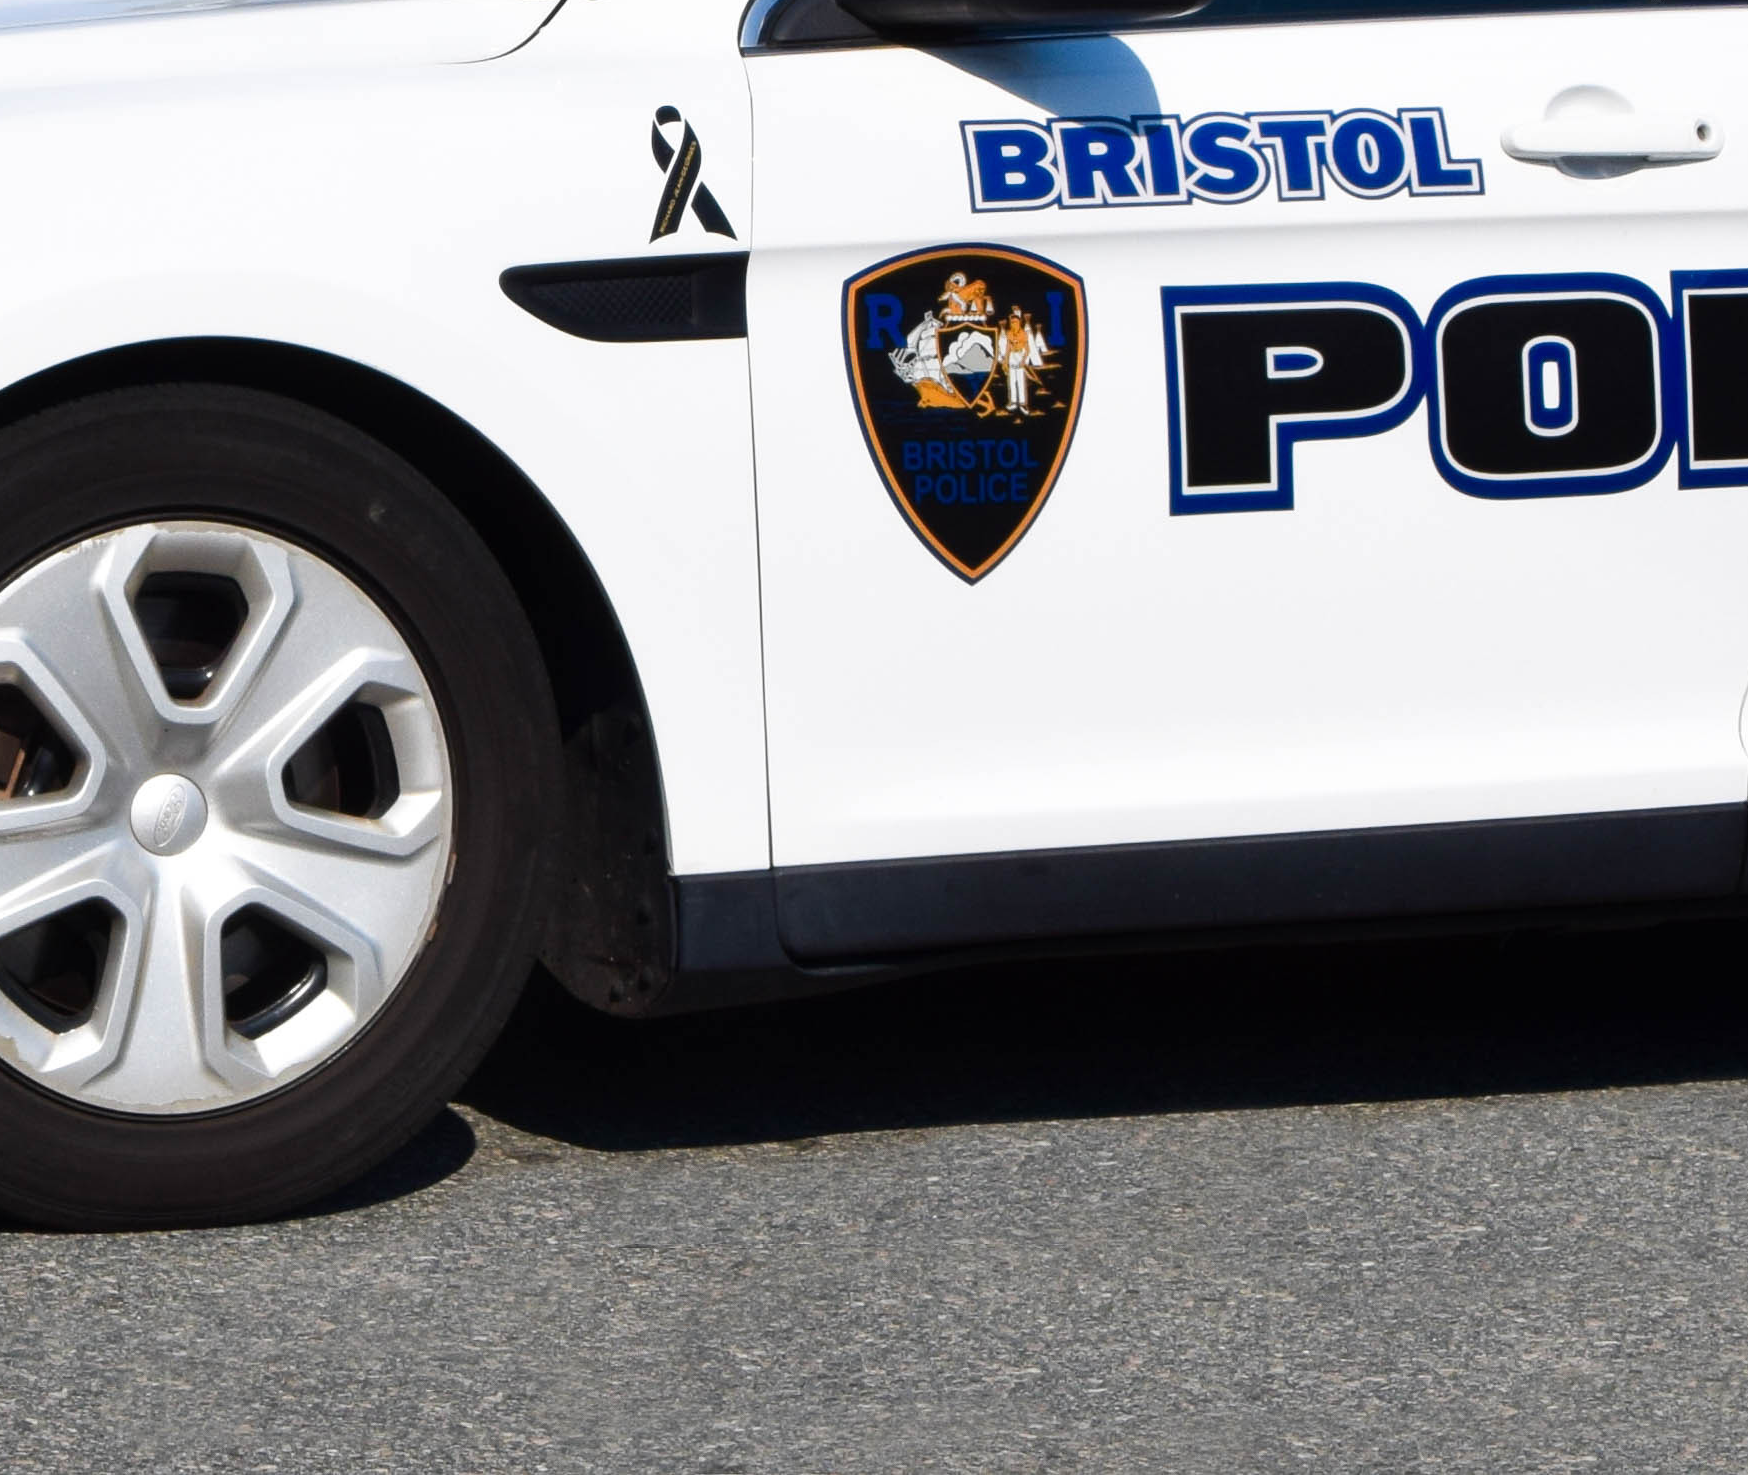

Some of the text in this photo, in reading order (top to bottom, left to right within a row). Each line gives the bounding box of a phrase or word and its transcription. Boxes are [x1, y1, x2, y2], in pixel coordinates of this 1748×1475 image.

[959, 107, 1485, 213] BRISTOL
[864, 293, 905, 350] R
[903, 439, 1039, 471] BRISTOL
[914, 473, 1030, 505] POLICE
